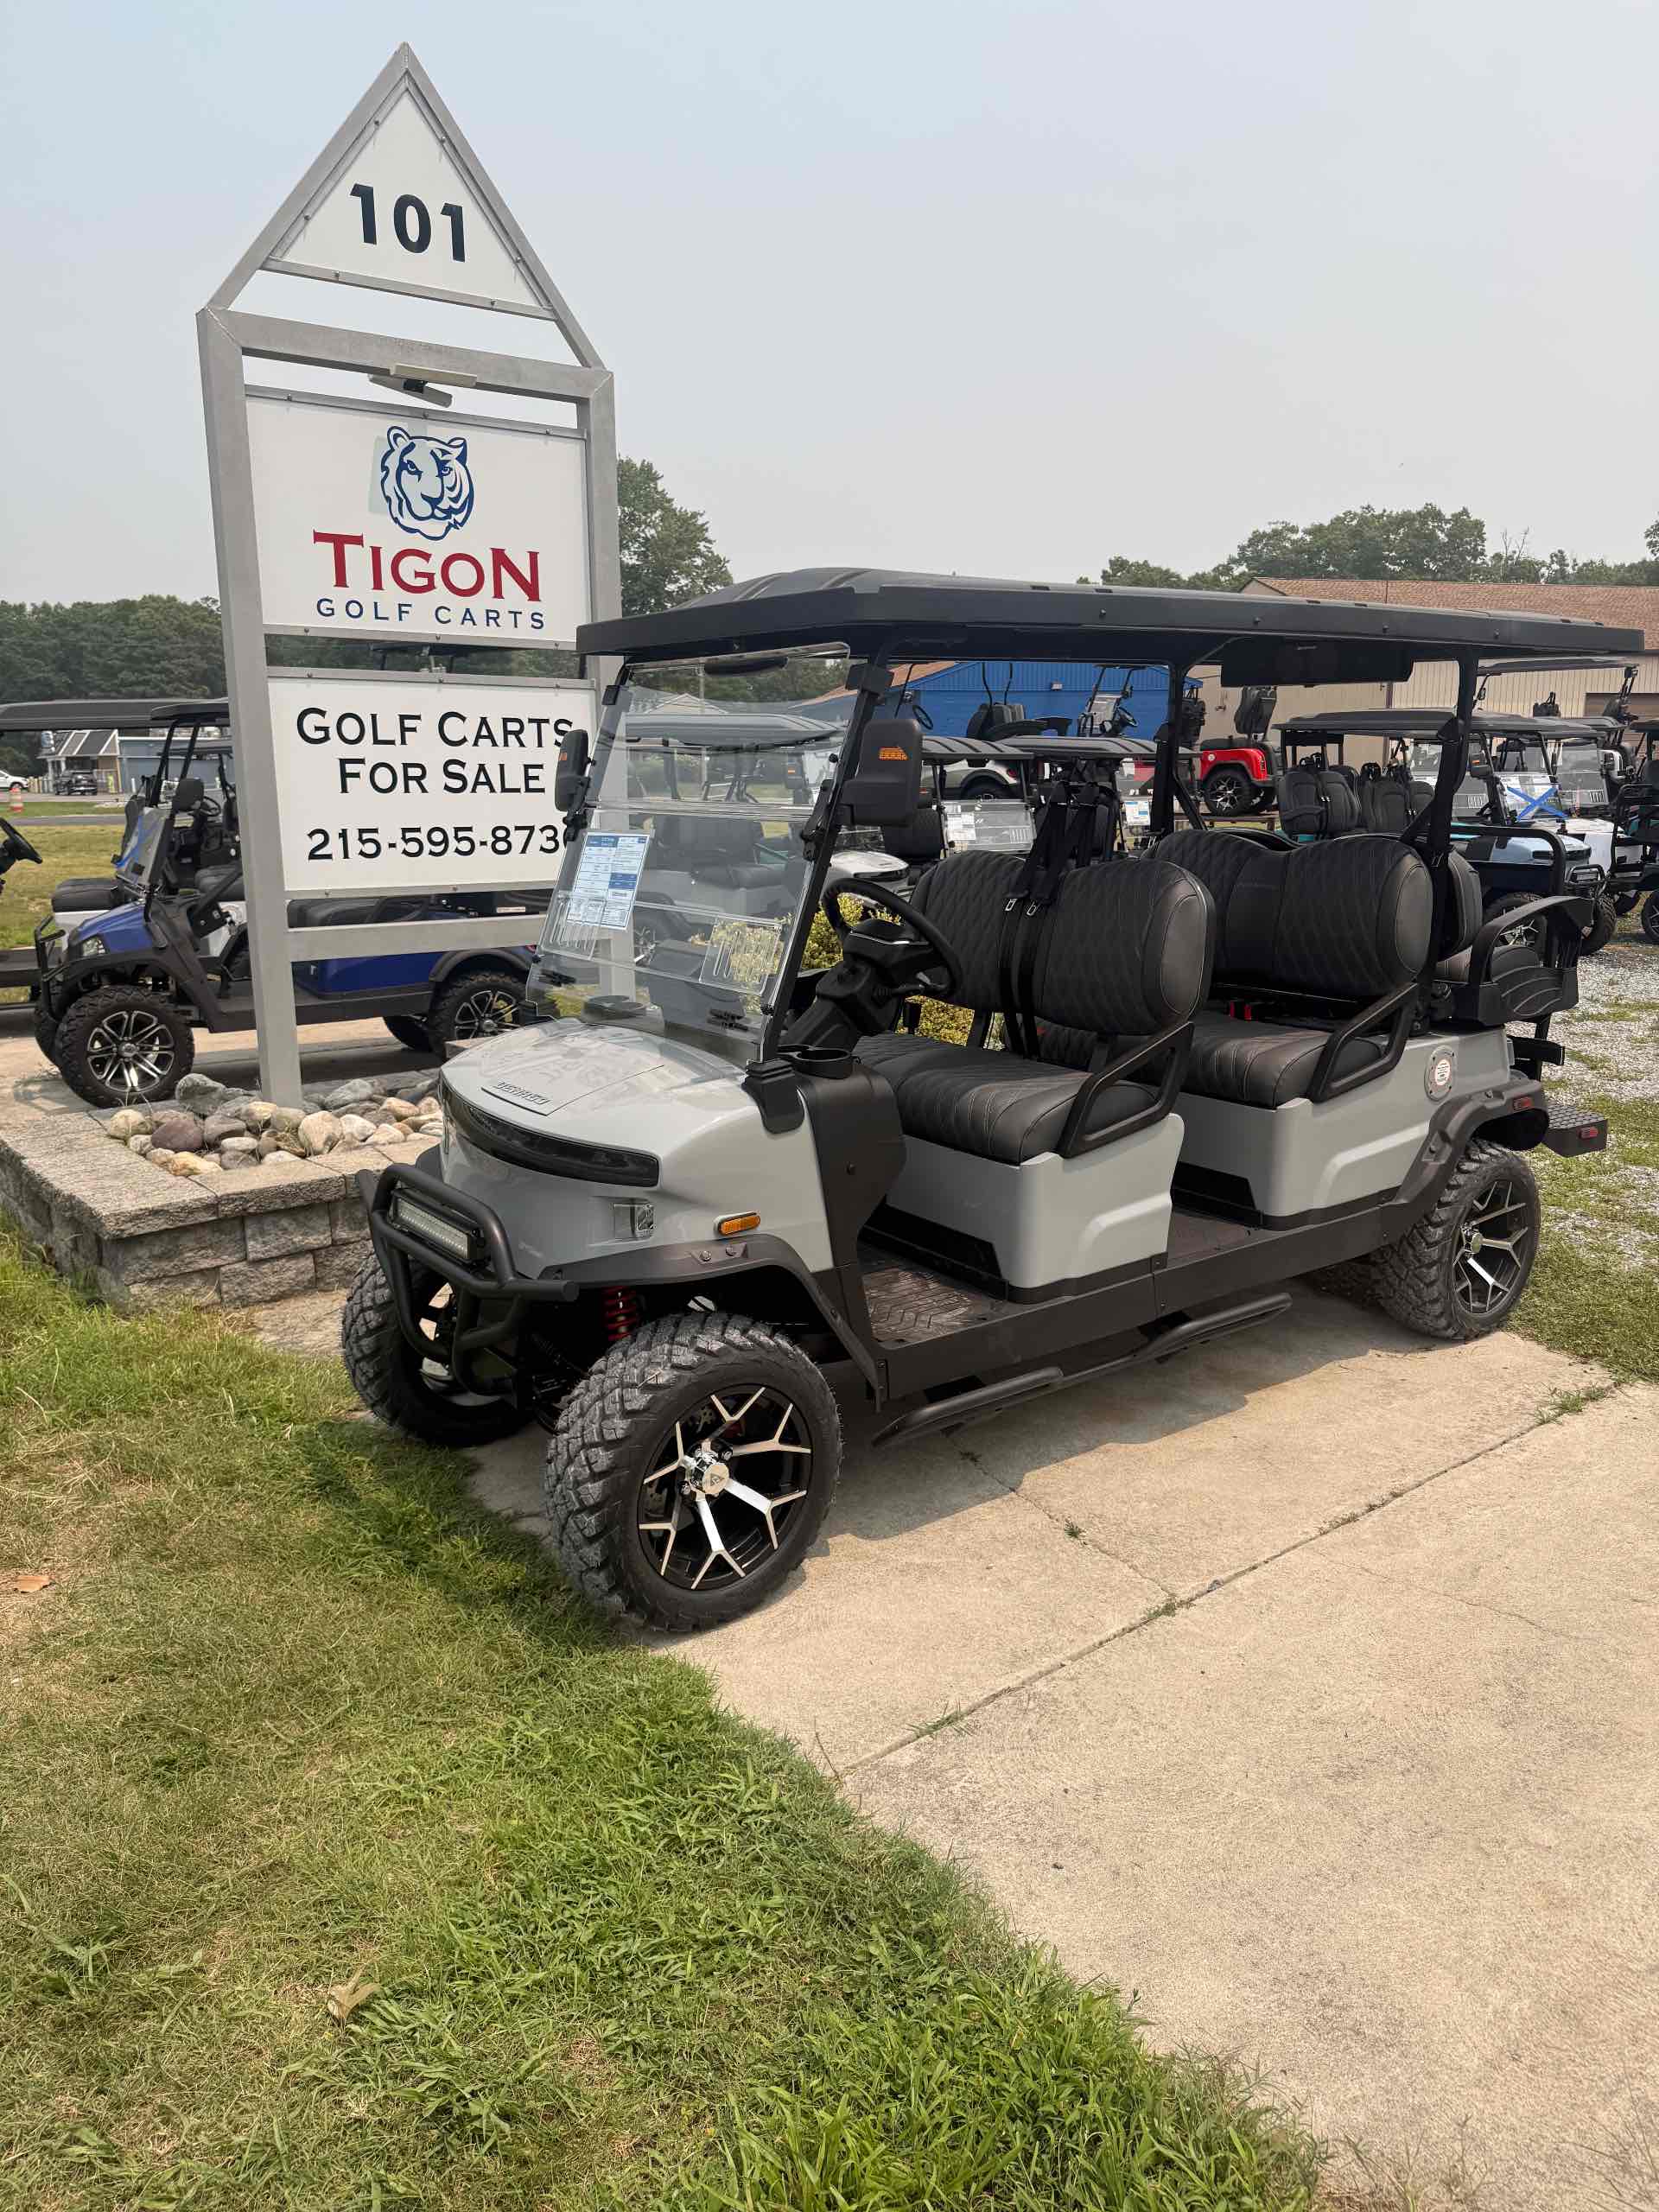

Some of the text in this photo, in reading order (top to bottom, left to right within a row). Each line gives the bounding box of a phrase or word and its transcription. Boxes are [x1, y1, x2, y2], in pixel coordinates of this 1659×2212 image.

[350, 183, 465, 263] 101
[313, 529, 541, 601] TIGON
[316, 598, 544, 629] GOLF CARTS
[296, 707, 422, 746] GOLF
[338, 758, 546, 794] FOR SALE
[307, 824, 568, 861] 215-595-873
